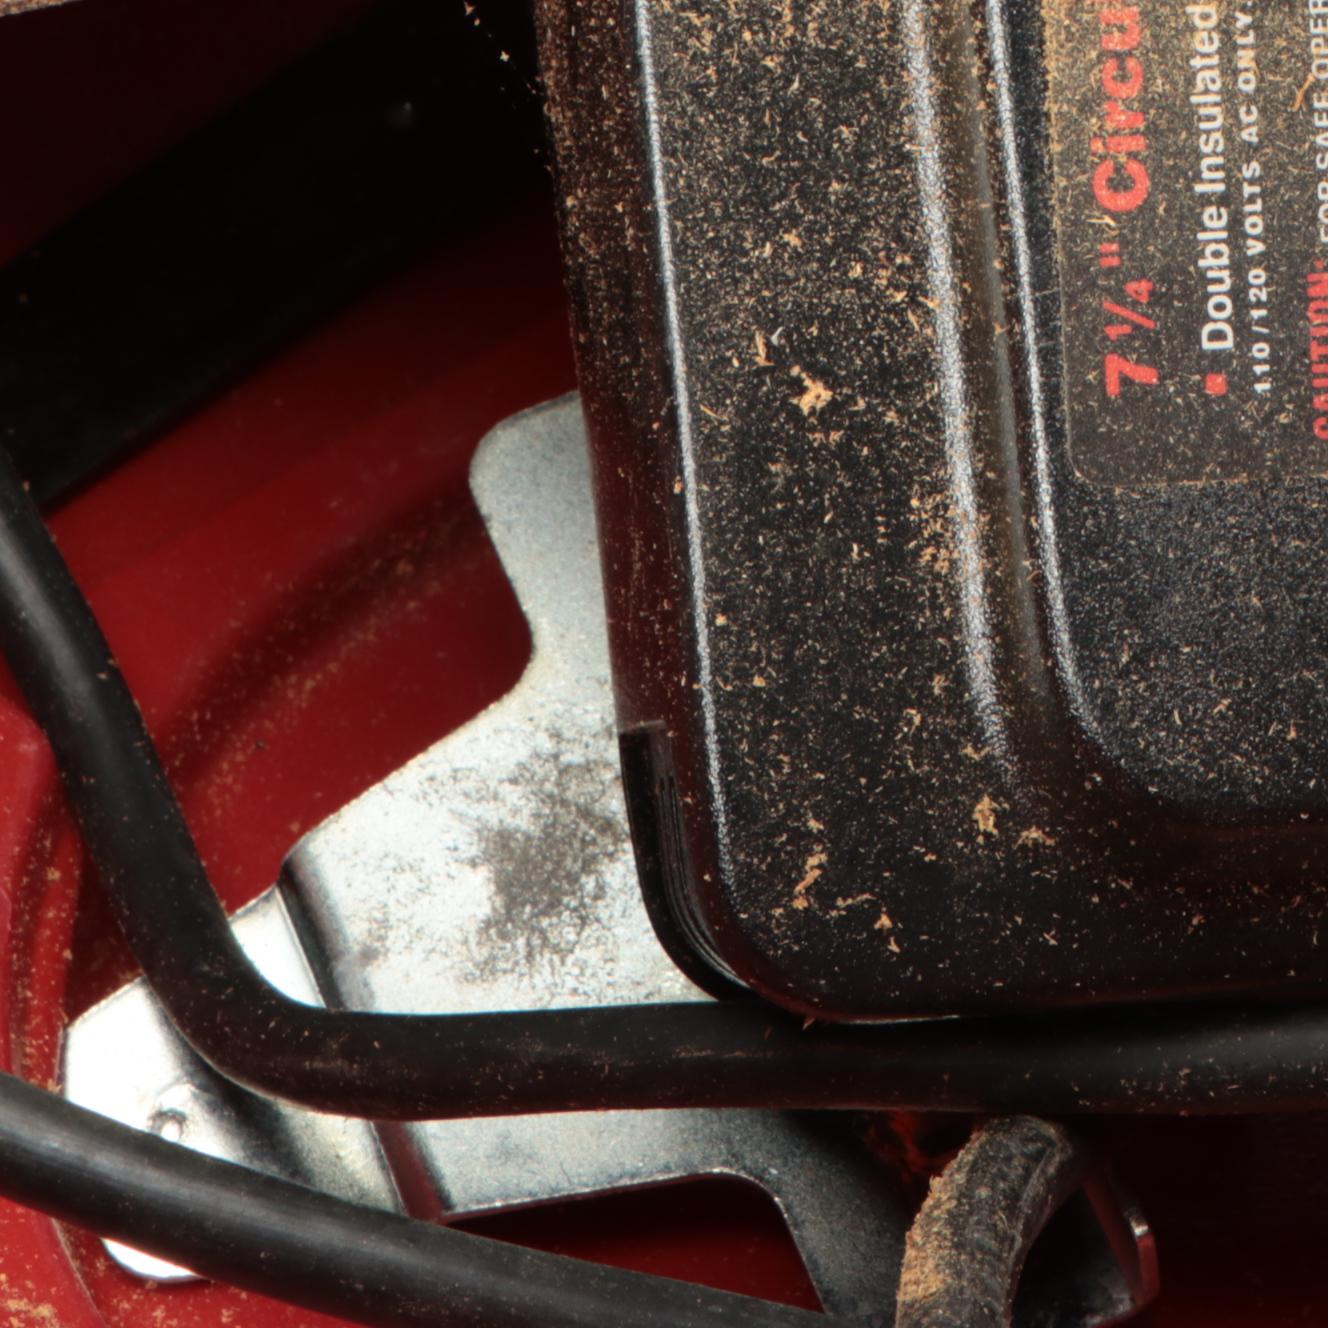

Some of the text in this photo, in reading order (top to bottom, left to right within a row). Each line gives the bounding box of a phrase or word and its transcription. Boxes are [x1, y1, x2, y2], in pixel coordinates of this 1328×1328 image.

[1184, 4, 1227, 193] Insulated
[1239, 104, 1258, 143] AC
[1242, 160, 1265, 255] VOLTS
[1194, 205, 1234, 350] Double
